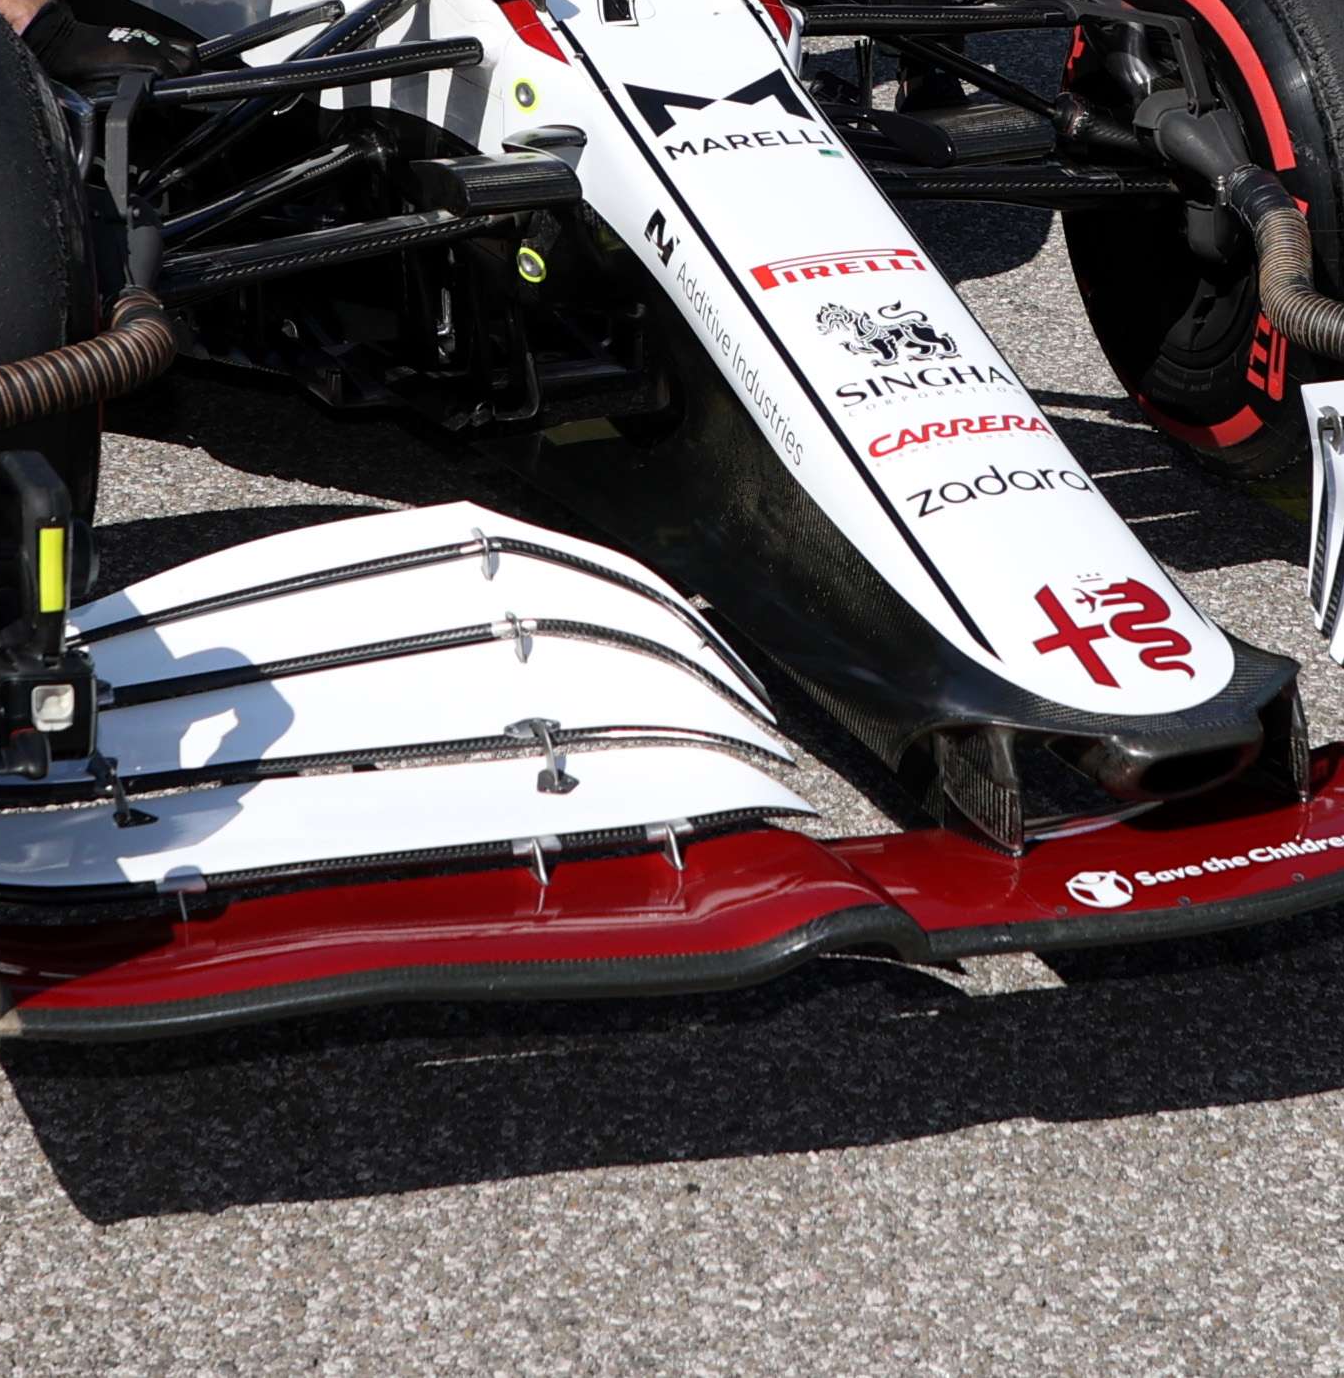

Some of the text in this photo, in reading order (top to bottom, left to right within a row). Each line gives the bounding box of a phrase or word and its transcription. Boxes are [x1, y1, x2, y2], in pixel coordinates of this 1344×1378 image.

[664, 129, 834, 161] MARELLI
[749, 248, 927, 291] PIRELLI
[676, 262, 805, 467] Additive Industries
[835, 365, 1015, 408] SINGHA
[848, 386, 1024, 418] CORPORATION
[868, 415, 1054, 458] CARRERA
[906, 464, 1096, 518] zadara
[1134, 863, 1204, 887] Save
[1202, 854, 1250, 873] the
